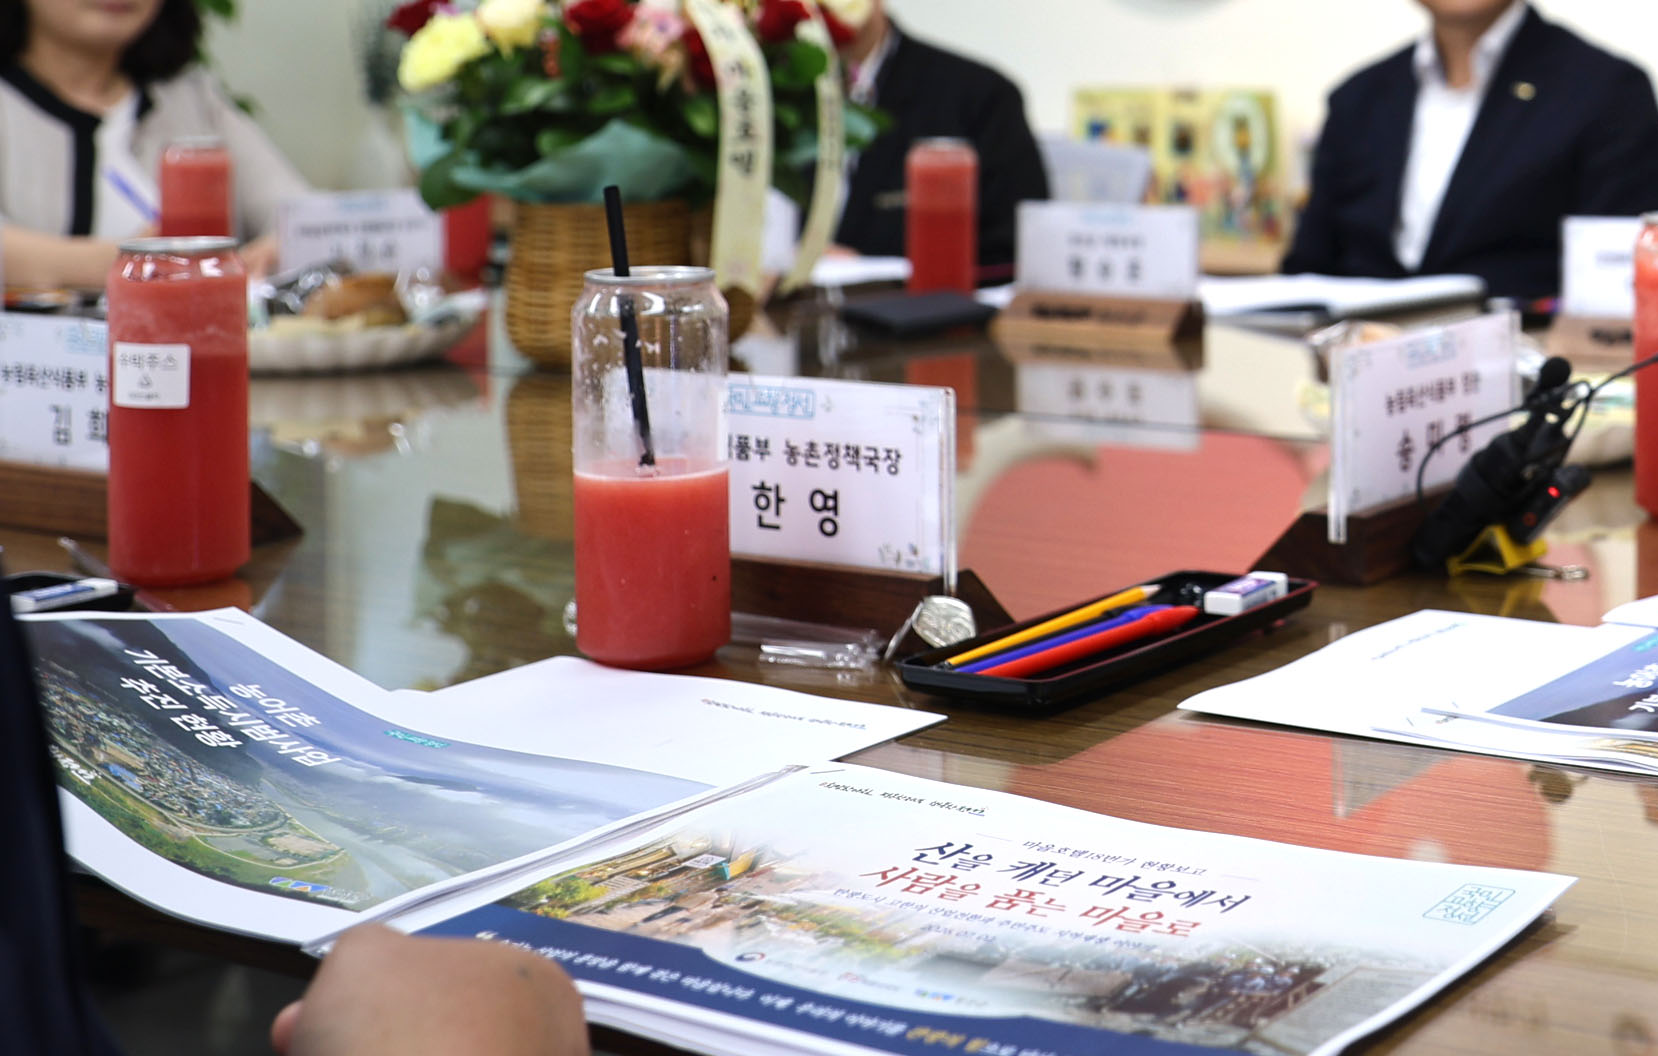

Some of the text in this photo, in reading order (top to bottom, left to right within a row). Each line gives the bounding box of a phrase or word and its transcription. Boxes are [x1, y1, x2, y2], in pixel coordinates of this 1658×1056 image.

[783, 439, 902, 476] 농촌정책국장
[118, 676, 243, 750] 추진 현황
[123, 647, 342, 768] 기본소득시범사업
[228, 683, 322, 729] 농어촌
[912, 842, 1252, 914] 산을 캐던 마을에서
[1021, 839, 1137, 866] 마을호텔18번가
[858, 865, 1202, 938] 사람을 품는 마을로
